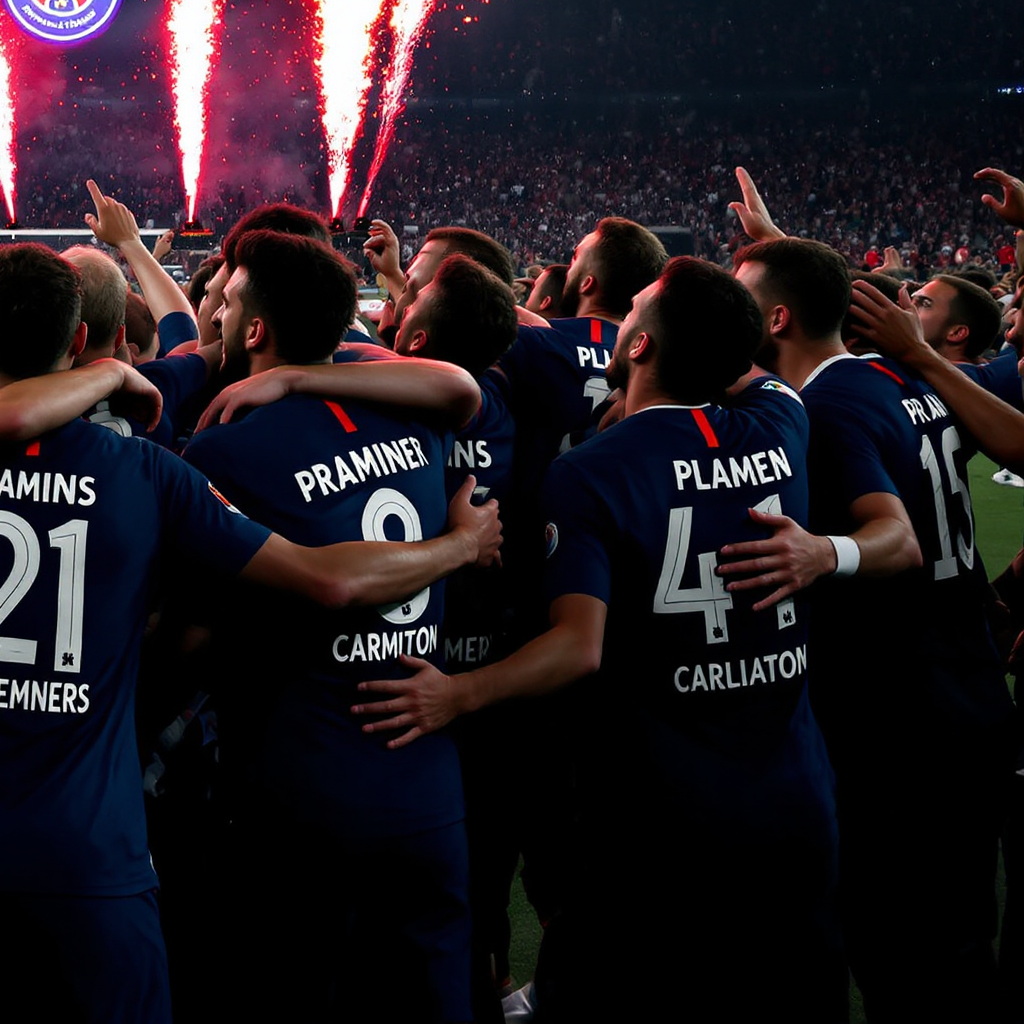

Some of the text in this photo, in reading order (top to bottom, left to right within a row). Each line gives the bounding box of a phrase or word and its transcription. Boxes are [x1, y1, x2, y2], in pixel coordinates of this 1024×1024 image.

[294, 436, 430, 502] PRAMINER
[673, 446, 792, 490] PLAMEN
[332, 624, 437, 662] CARMITON
[674, 644, 807, 693] CARLIATON
